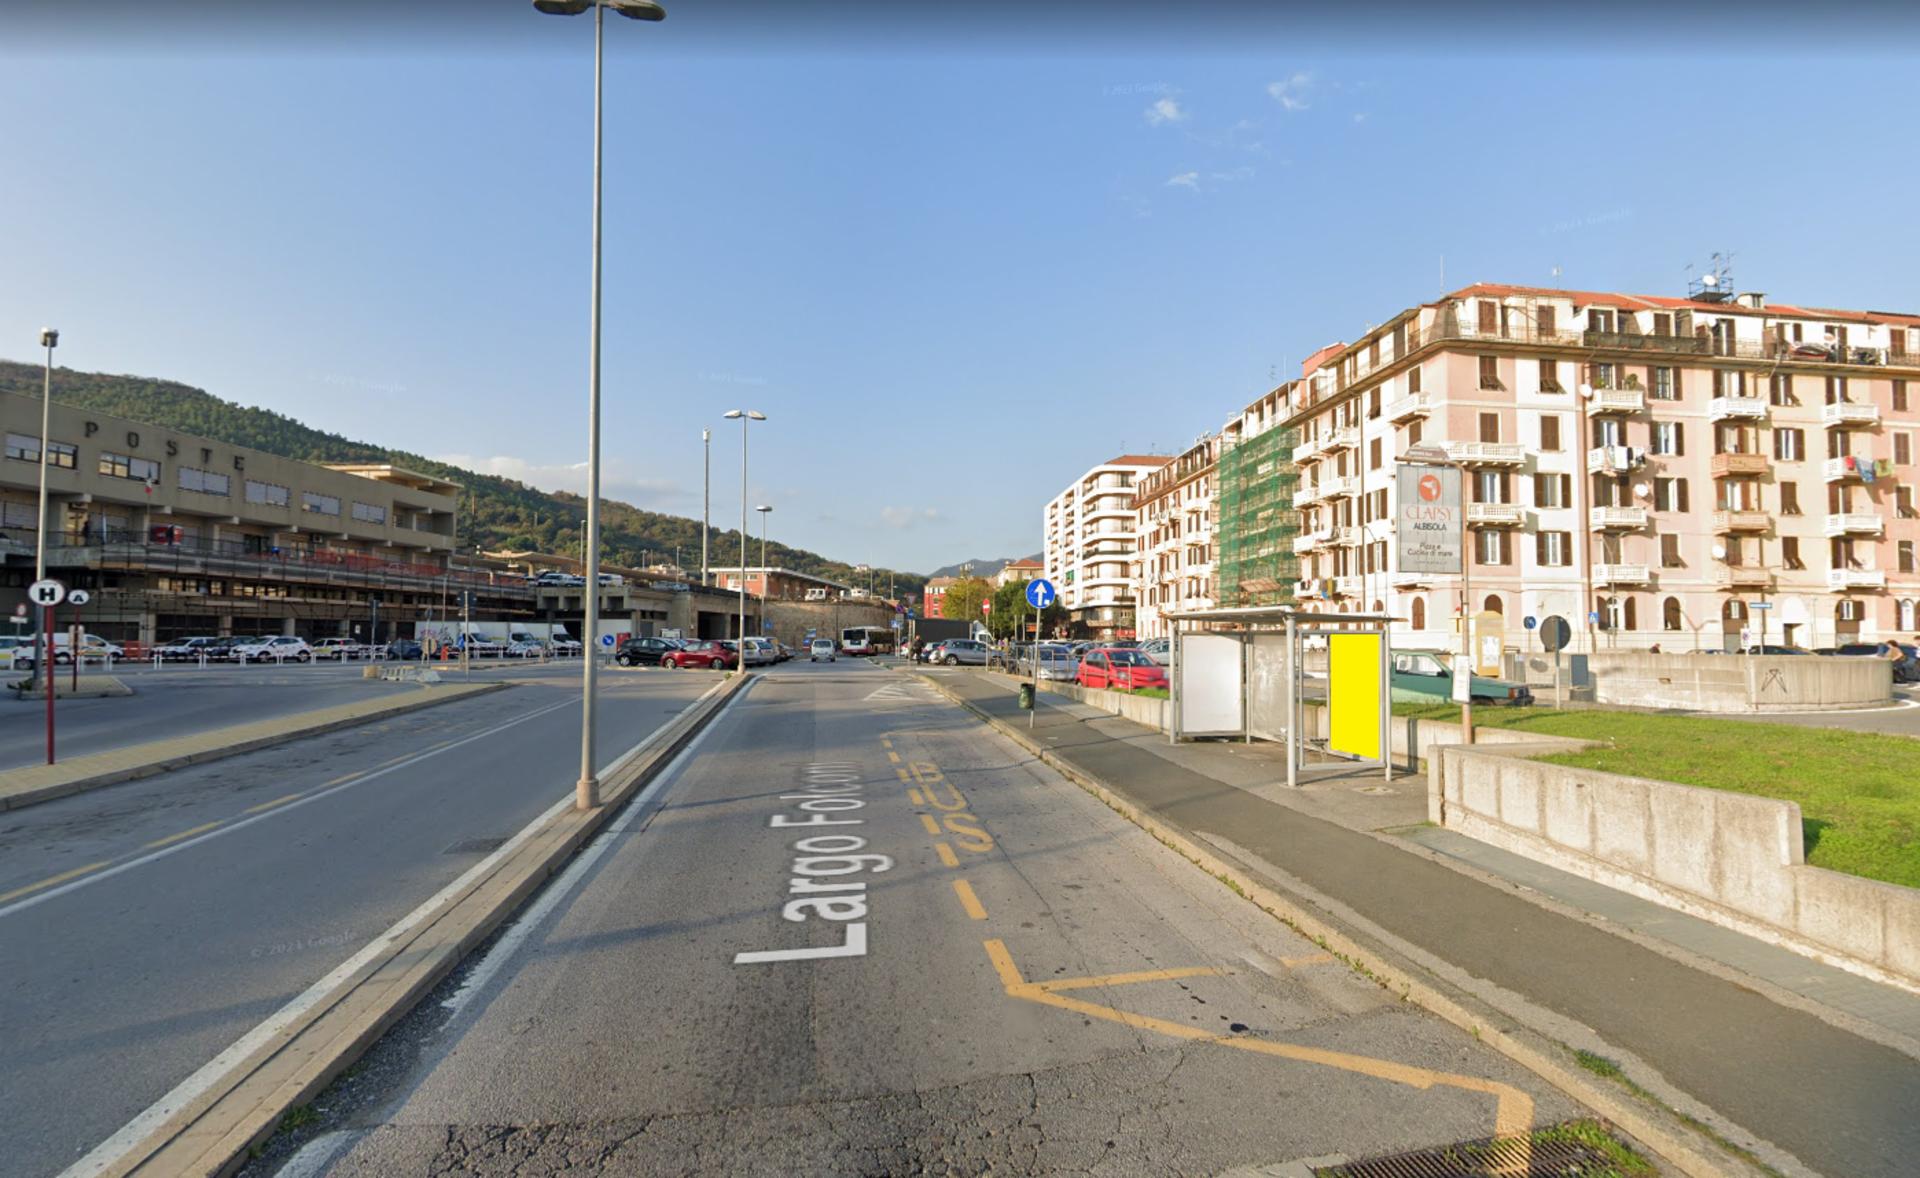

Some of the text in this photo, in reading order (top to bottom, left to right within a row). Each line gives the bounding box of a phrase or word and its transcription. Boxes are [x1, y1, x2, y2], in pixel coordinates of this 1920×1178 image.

[84, 421, 246, 472] POSTE
[1413, 522, 1447, 531] ALBISOLA
[39, 587, 55, 601] H
[73, 594, 84, 602] A
[908, 761, 994, 853] BUS
